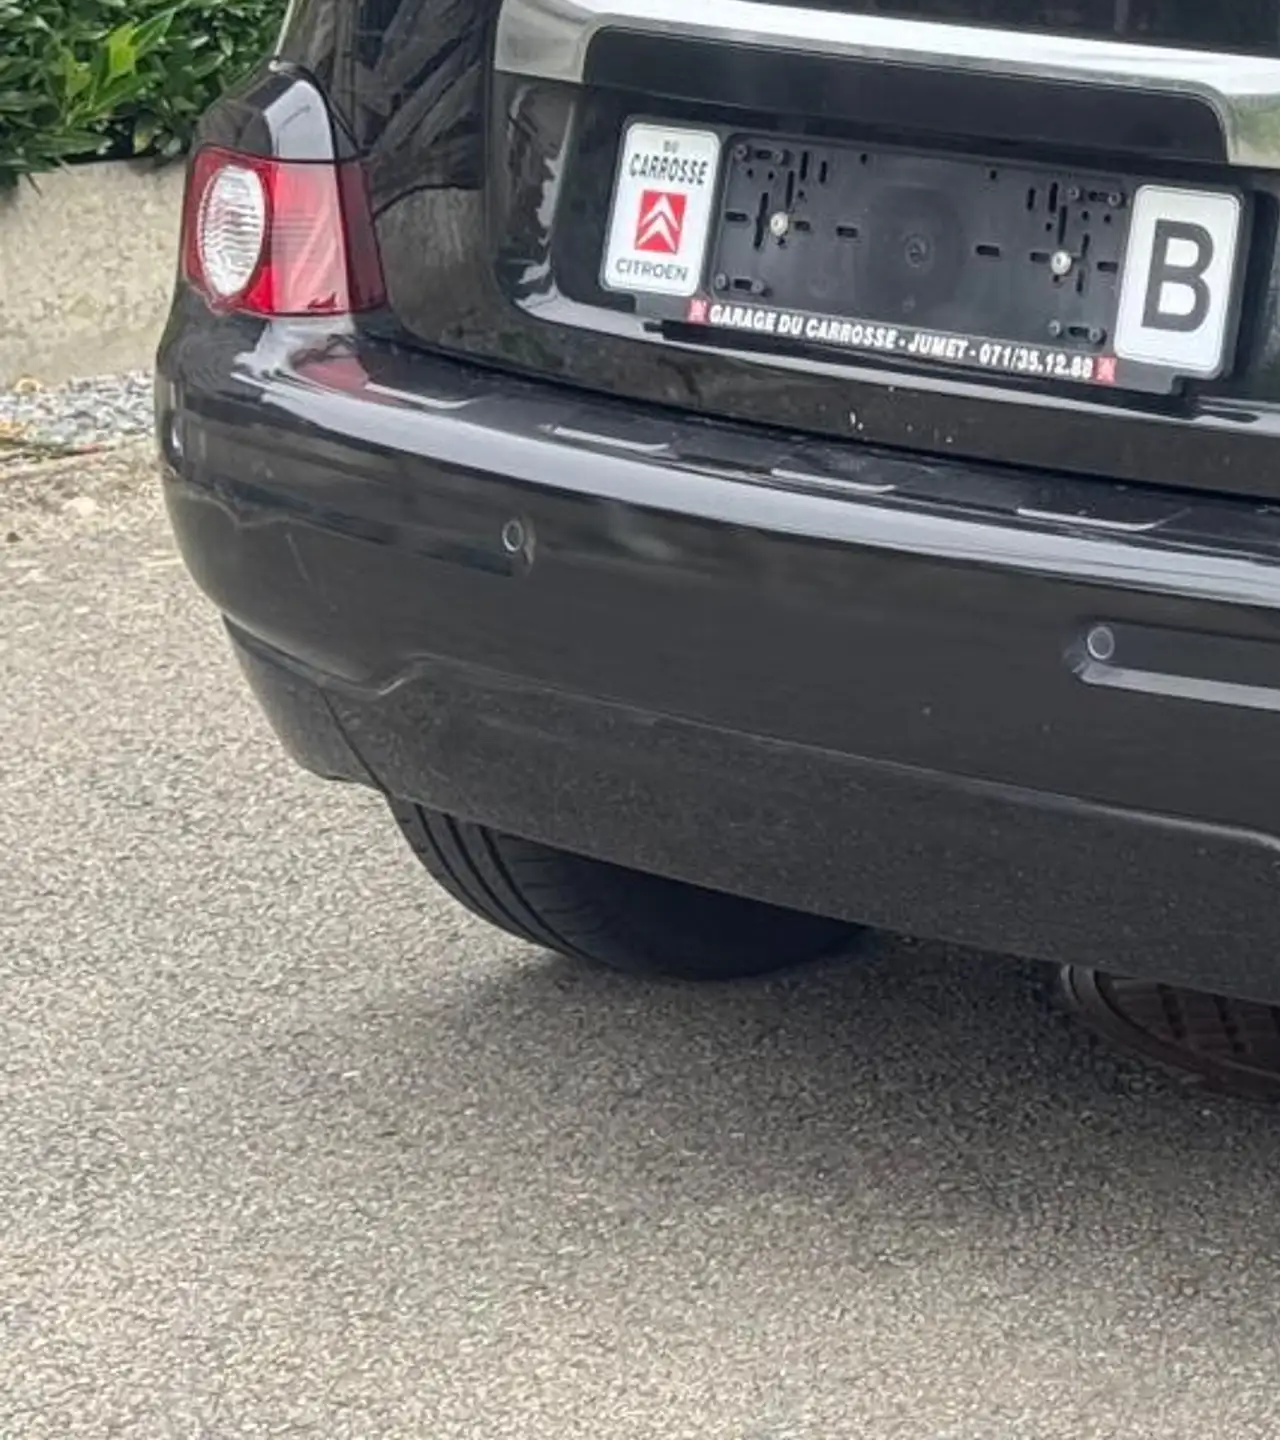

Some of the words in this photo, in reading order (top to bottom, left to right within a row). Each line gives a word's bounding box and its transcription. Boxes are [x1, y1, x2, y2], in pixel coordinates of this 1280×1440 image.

[628, 153, 709, 185] CARROSSE
[1141, 218, 1215, 333] B
[709, 303, 775, 333] GARAGE
[777, 313, 805, 336] DU
[805, 317, 900, 350] CARROSSE
[908, 332, 969, 359] JUMET
